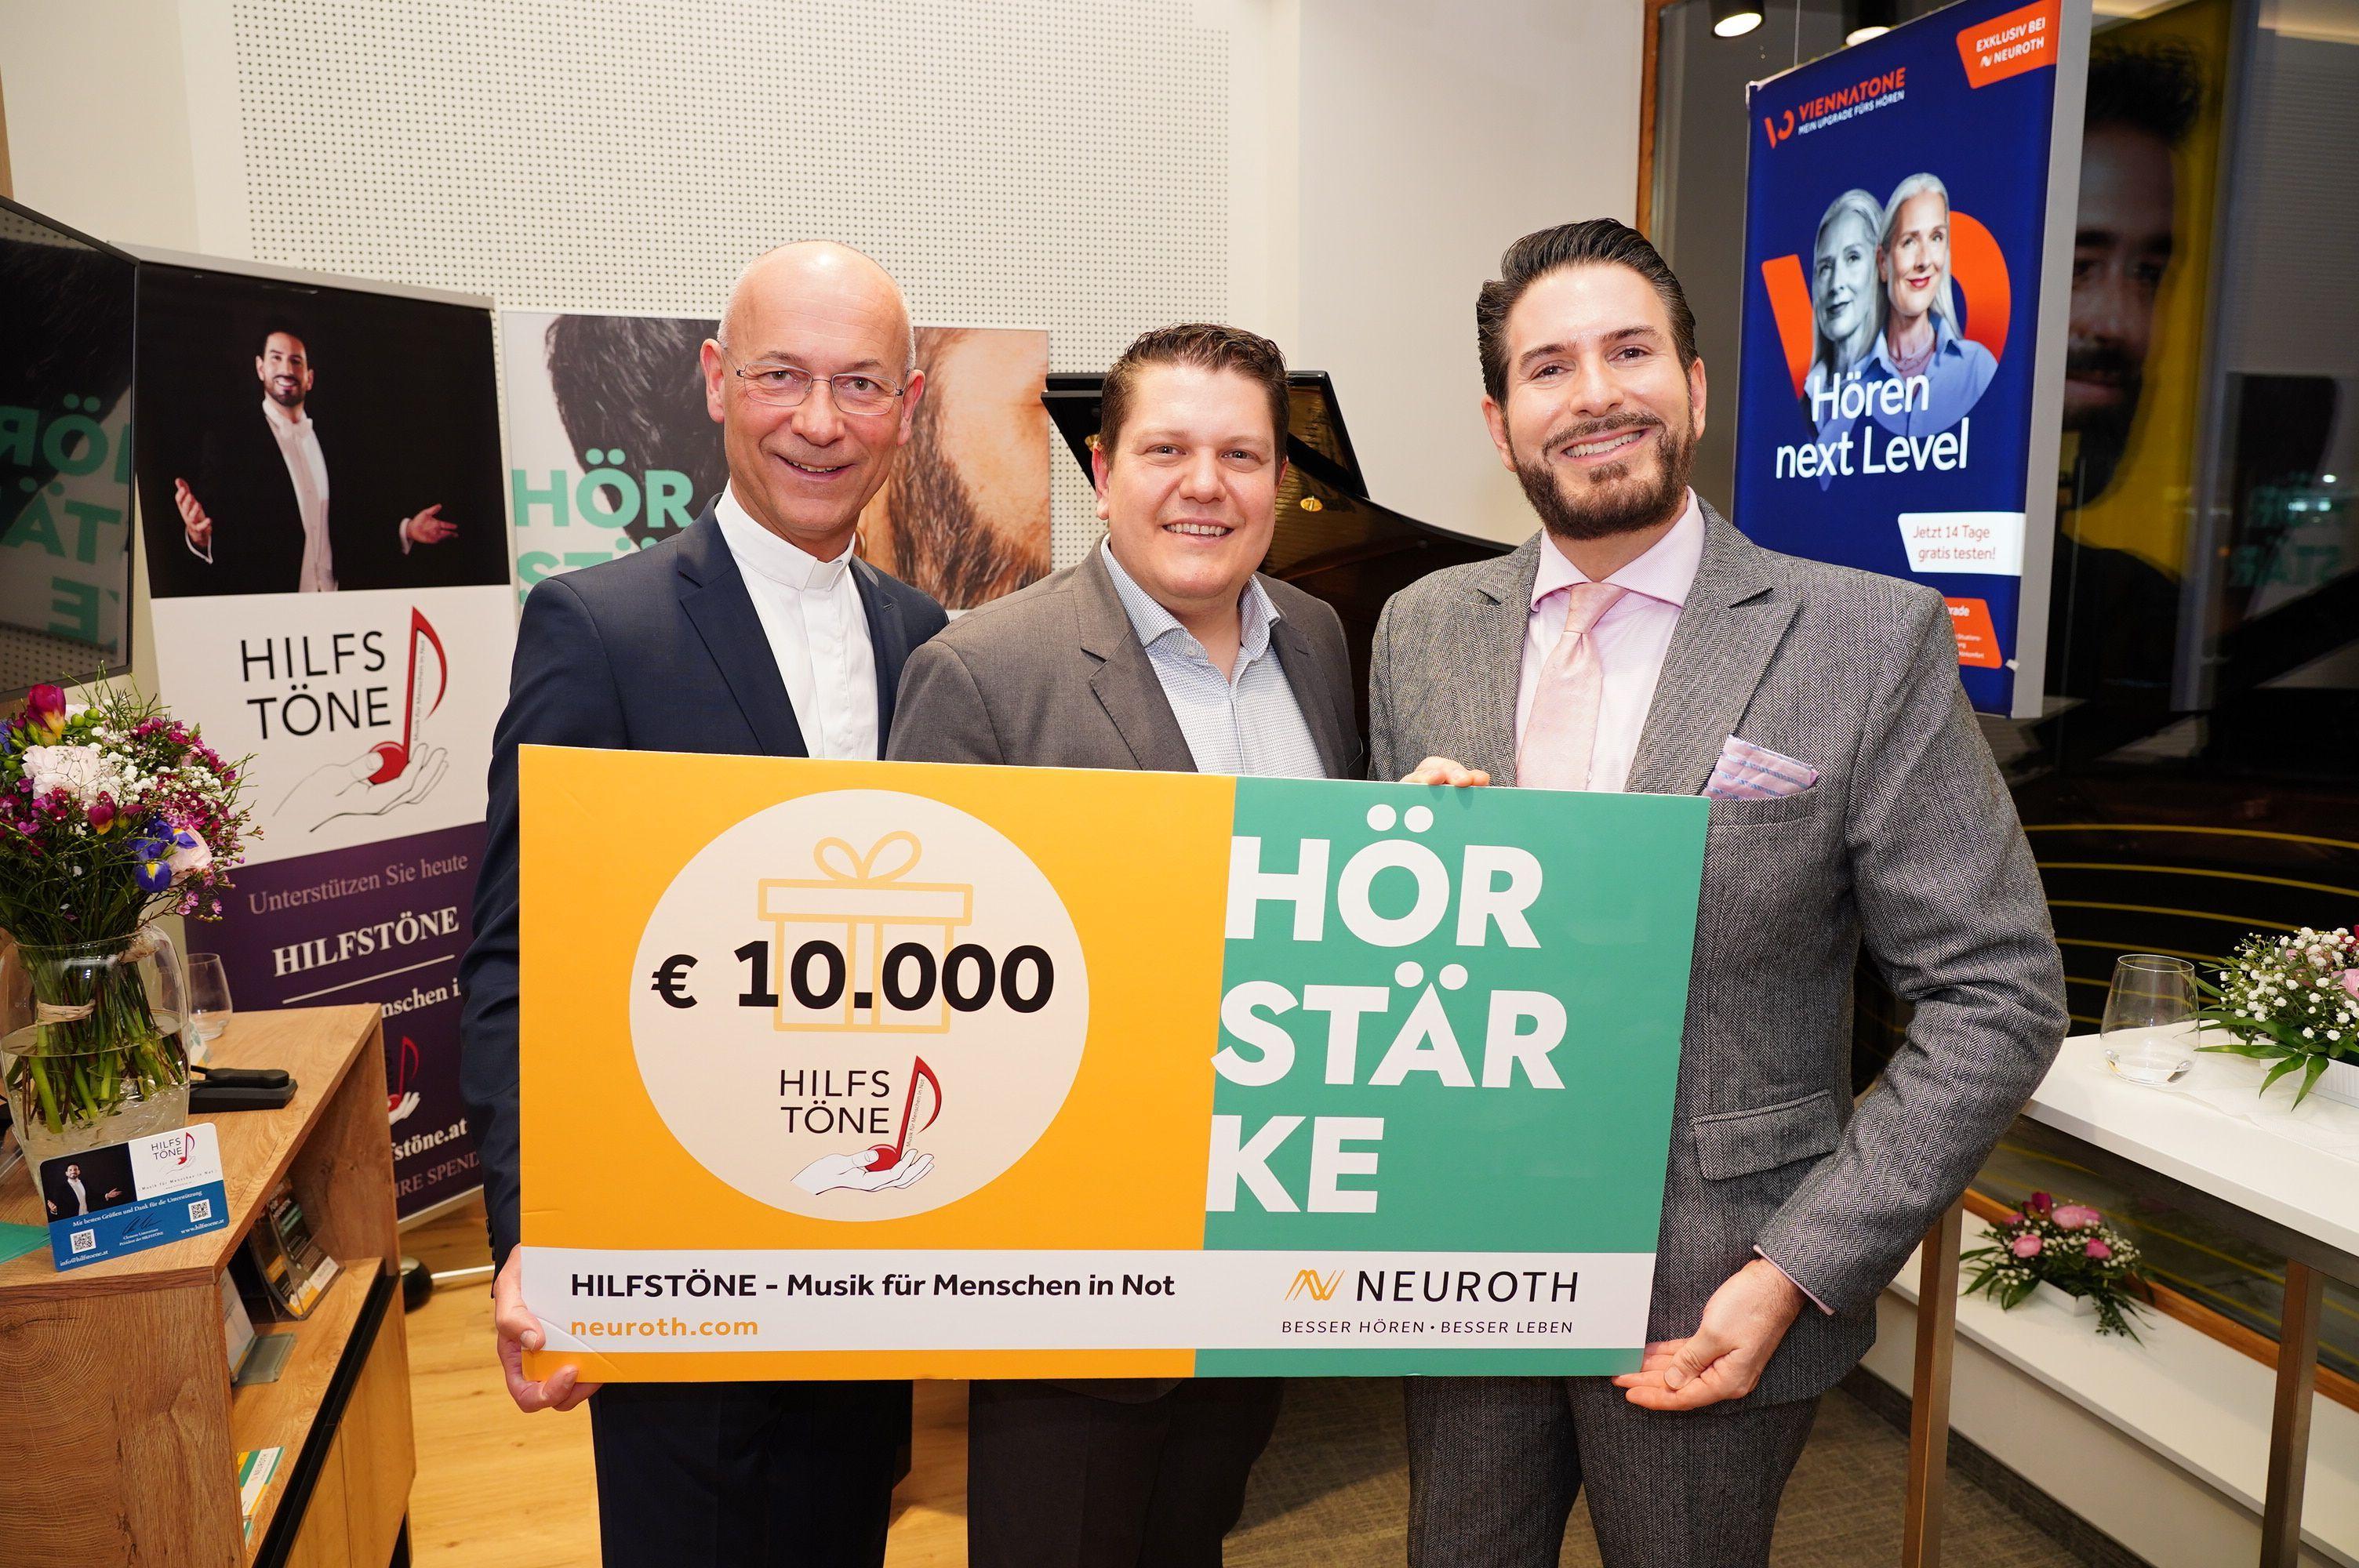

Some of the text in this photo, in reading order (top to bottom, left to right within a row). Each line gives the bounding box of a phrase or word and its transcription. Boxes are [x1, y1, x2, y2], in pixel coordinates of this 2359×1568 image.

[1976, 16, 2046, 53] EXKLUSIV BEI
[1994, 36, 2045, 64] NEUROTH
[1798, 67, 1906, 122] VIENNATONE
[1798, 122, 1817, 136] MEIN
[1817, 107, 1854, 129] UPGRADE
[1812, 372, 1930, 422] Hören
[1776, 417, 1970, 478] next Level
[511, 448, 696, 529] HÖR
[1913, 524, 1990, 543] Jetzt 14 Tage
[1918, 546, 1996, 562] gratis testen!
[241, 630, 385, 681] HILFS
[247, 683, 391, 739] TÖNE
[249, 853, 469, 915] Unterstützen Sie heute
[1224, 804, 1543, 949] HÖR
[272, 906, 460, 978] HILFSTÖNE
[649, 941, 1055, 1014] € 10.000
[381, 987, 449, 1018] nschen
[1210, 960, 1568, 1090] STÄR
[780, 1069, 890, 1097] HILFS
[780, 1101, 889, 1134] TÖNE
[912, 1096, 921, 1122] Menschen
[151, 1138, 181, 1152] HILFS
[153, 1146, 183, 1160] TÖNE
[1205, 1114, 1385, 1214] KE
[84, 1215, 101, 1224] besten
[167, 1191, 203, 1203] Unterstützung
[180, 1218, 224, 1234] www.hilfstoene.at
[60, 1250, 108, 1266] info@hilfstoene.at
[572, 1269, 757, 1297] HILFSTÖNE
[787, 1274, 875, 1297] Musik
[881, 1273, 926, 1296] für
[933, 1274, 1081, 1296] Menschen
[1089, 1274, 1114, 1296] in
[1121, 1274, 1176, 1296] Not
[1357, 1270, 1578, 1303] NEUROTH
[571, 1316, 758, 1338] neuroth.com
[1281, 1319, 1572, 1334] BESSER HÖREN BESSER LEBEN
